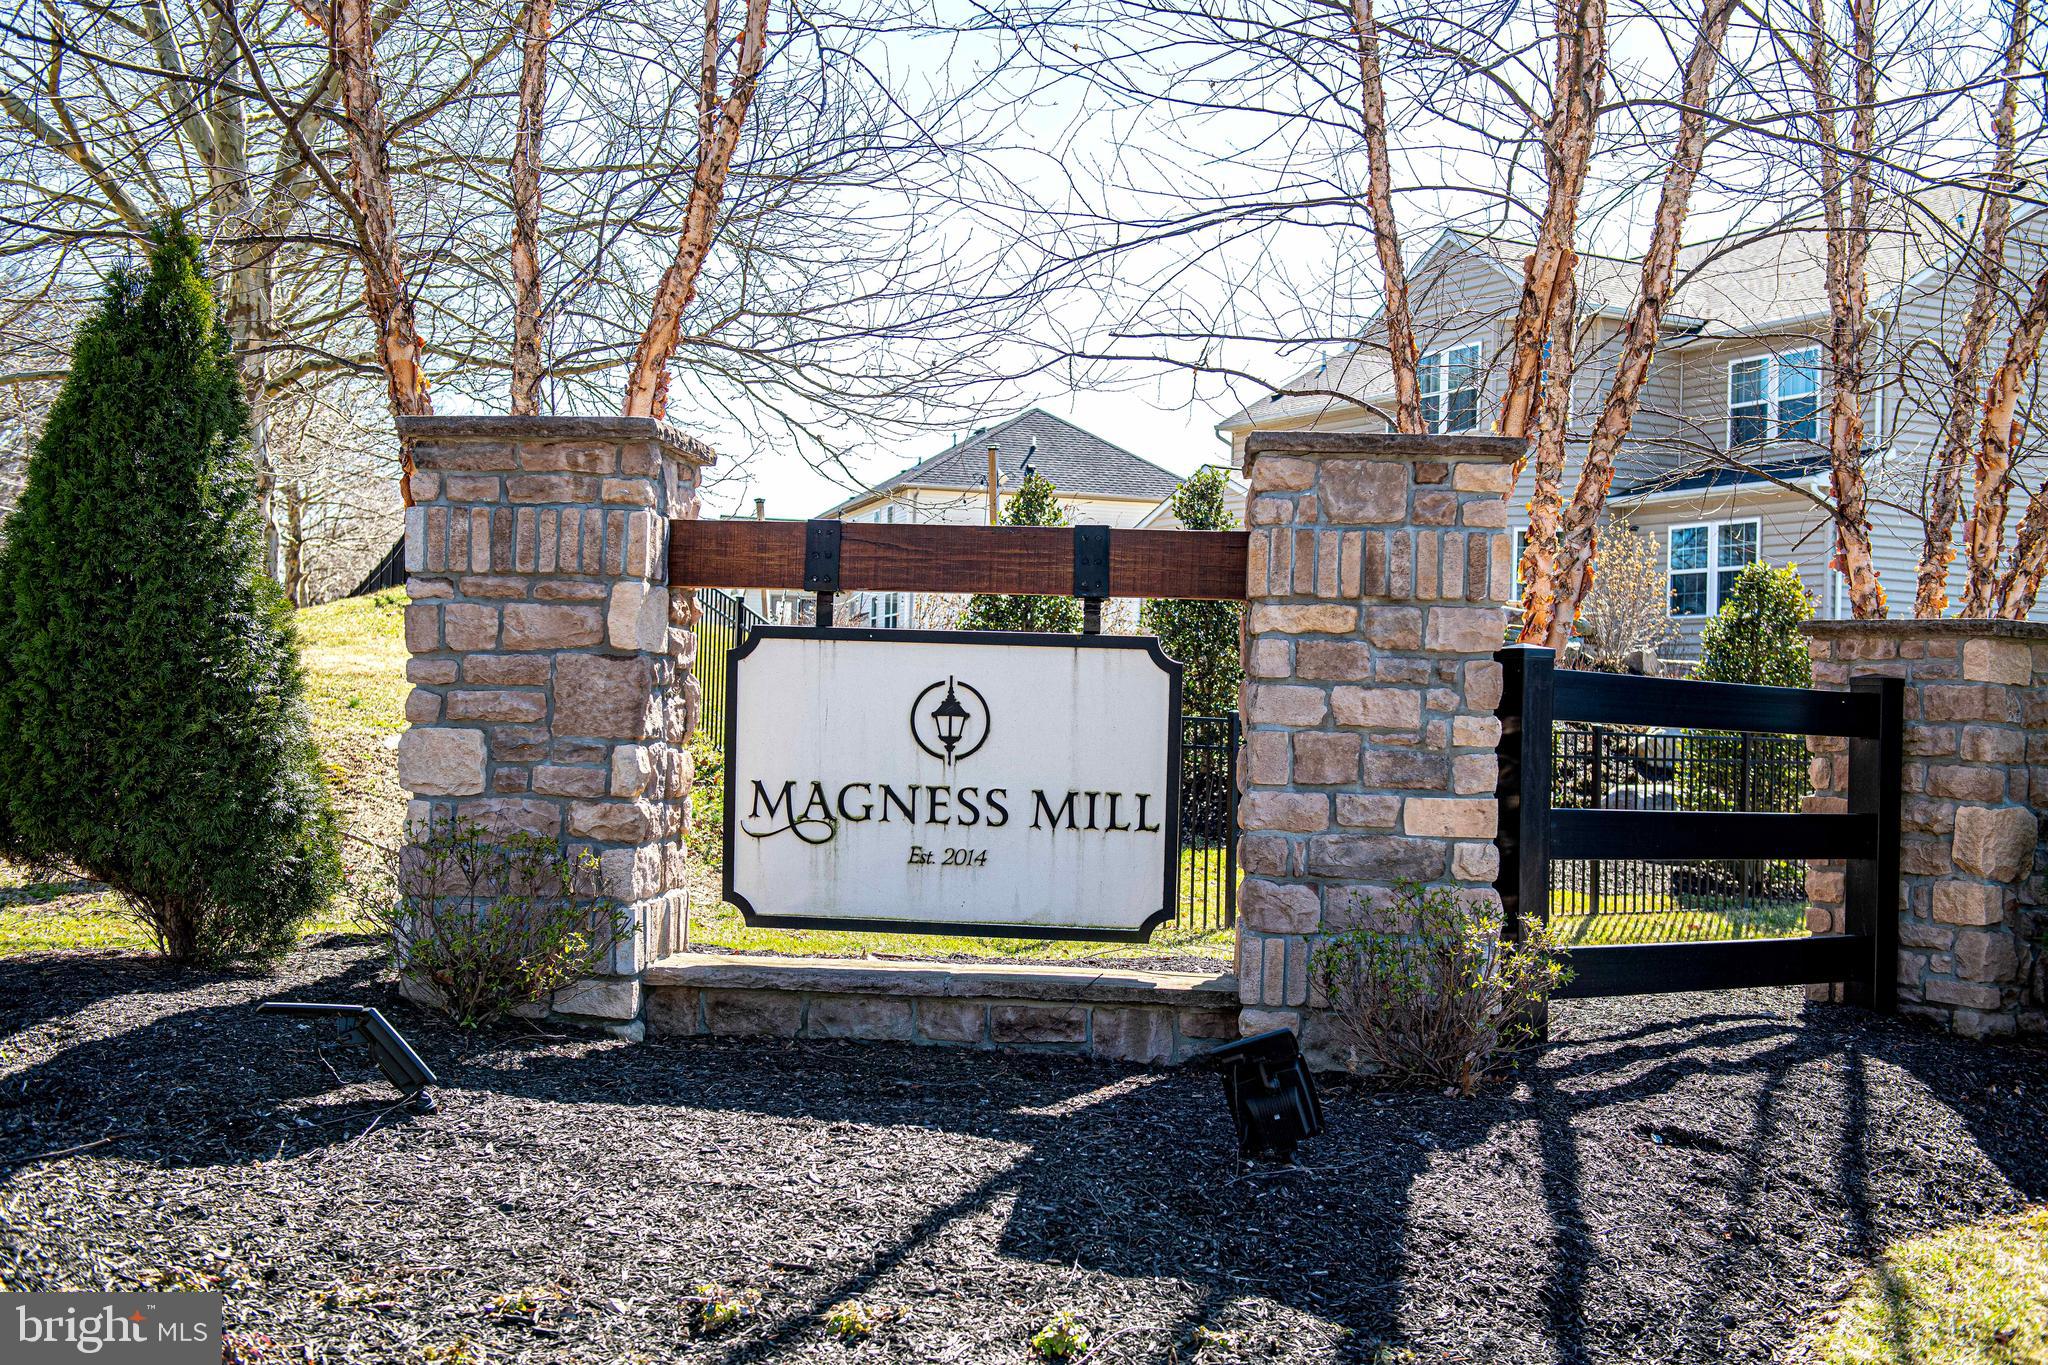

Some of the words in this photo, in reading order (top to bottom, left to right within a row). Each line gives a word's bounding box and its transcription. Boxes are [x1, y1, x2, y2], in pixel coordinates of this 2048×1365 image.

[740, 779, 1009, 844] MAGNESS
[1029, 789, 1161, 833] MILL
[907, 846, 936, 866] Est.
[941, 847, 987, 867] 2014
